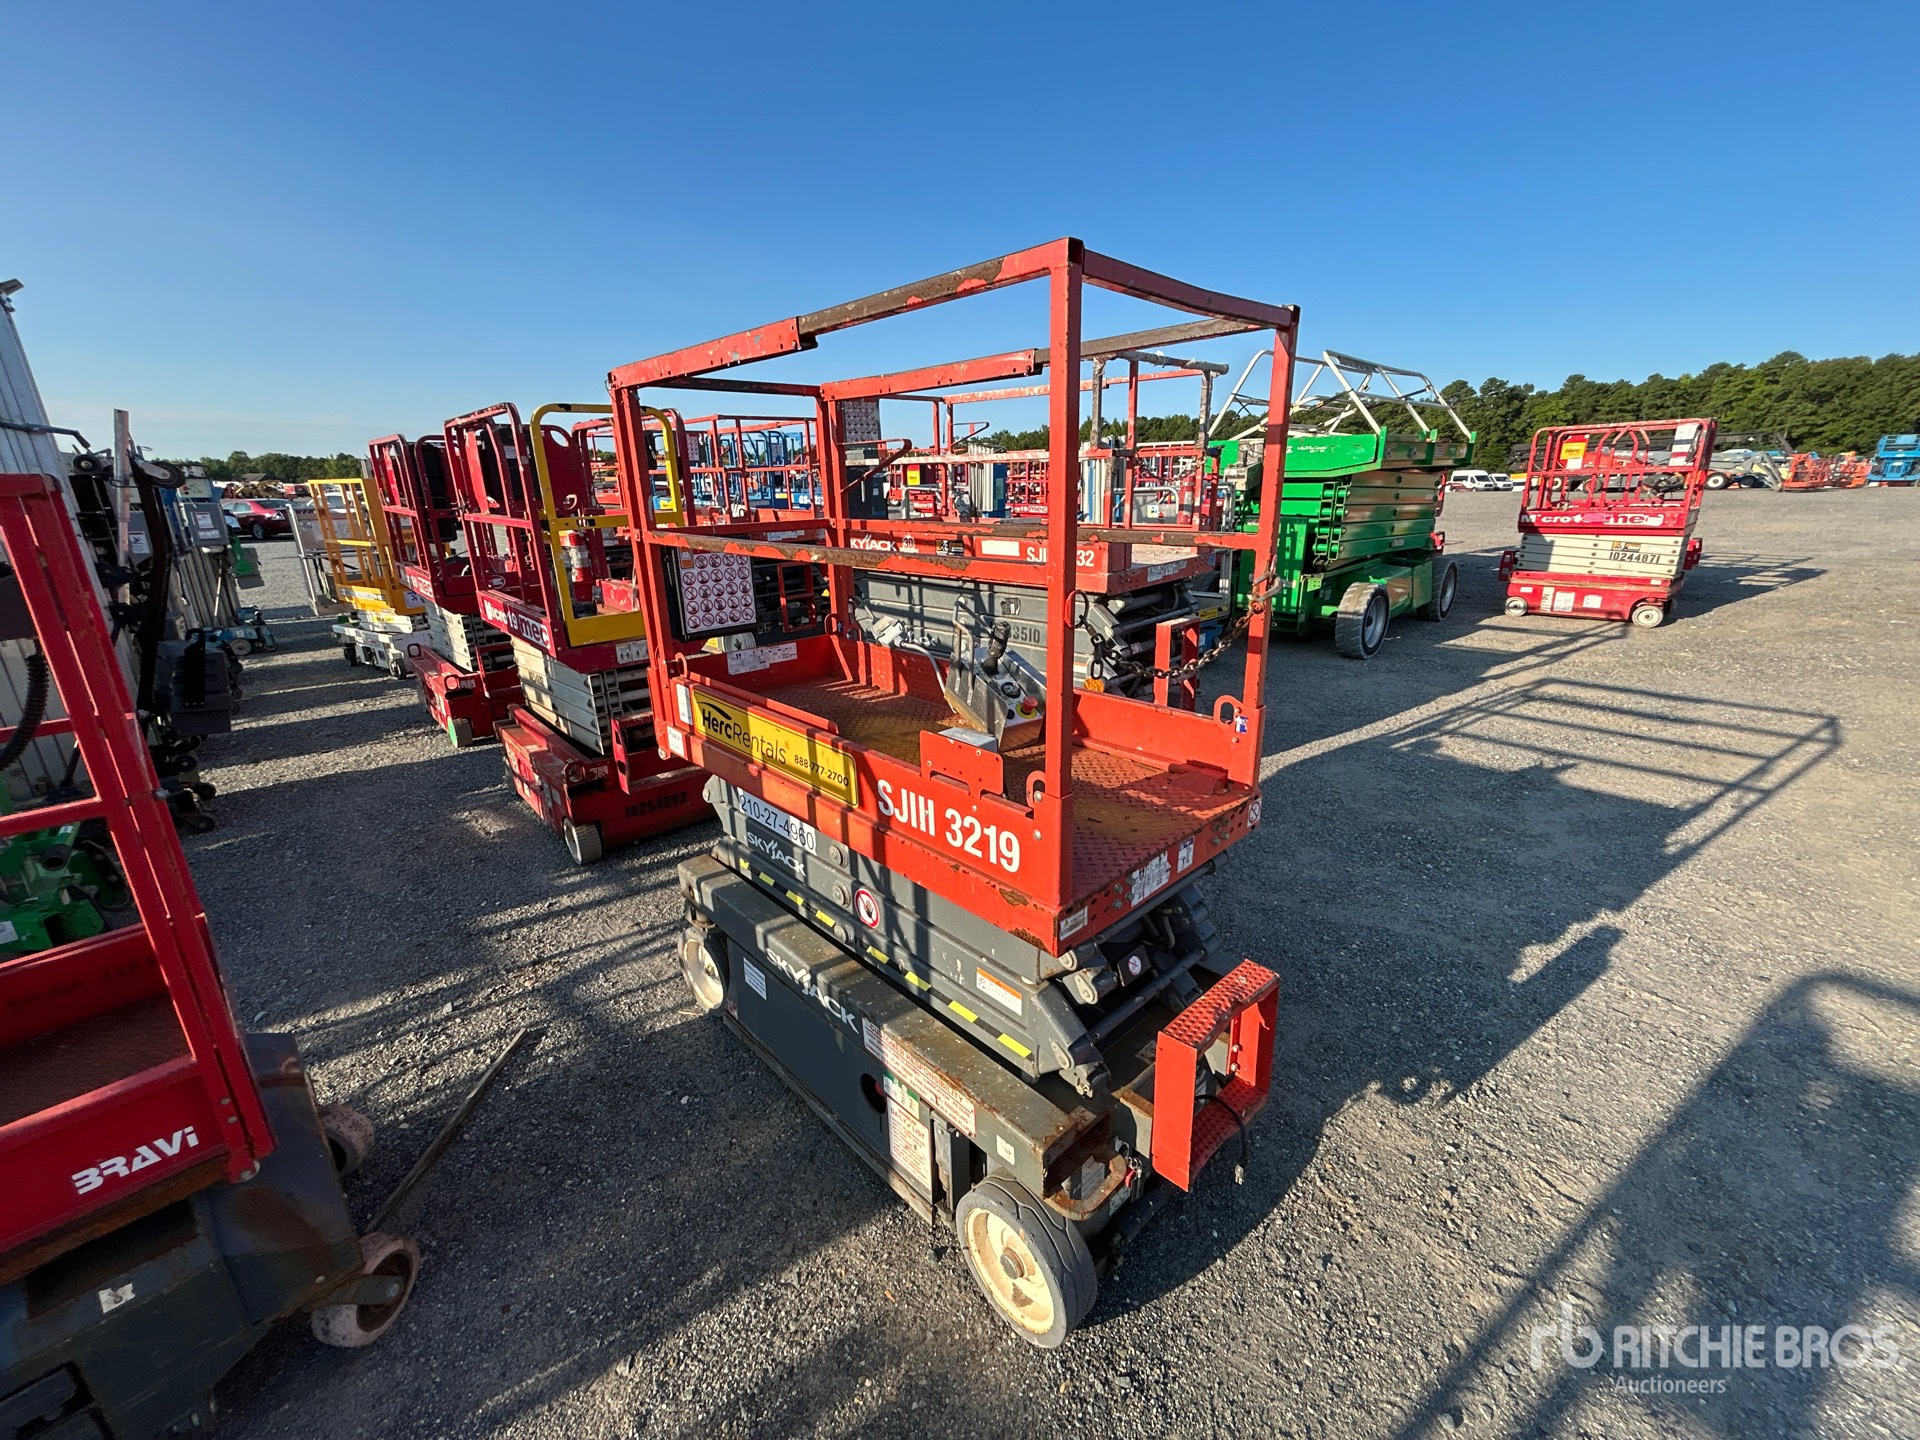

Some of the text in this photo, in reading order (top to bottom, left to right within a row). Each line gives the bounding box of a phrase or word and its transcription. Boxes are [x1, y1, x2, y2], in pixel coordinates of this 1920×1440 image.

[850, 534, 898, 552] KYJACK
[1076, 549, 1095, 567] 32
[1609, 551, 1660, 564] 10244871
[1009, 625, 1041, 644] 3510
[794, 754, 850, 787] 888-777-2700
[740, 794, 816, 851] 210-27-4960
[746, 831, 806, 876] SKYJACK
[944, 807, 1021, 874] 3219
[765, 947, 860, 1035] SKYJACK
